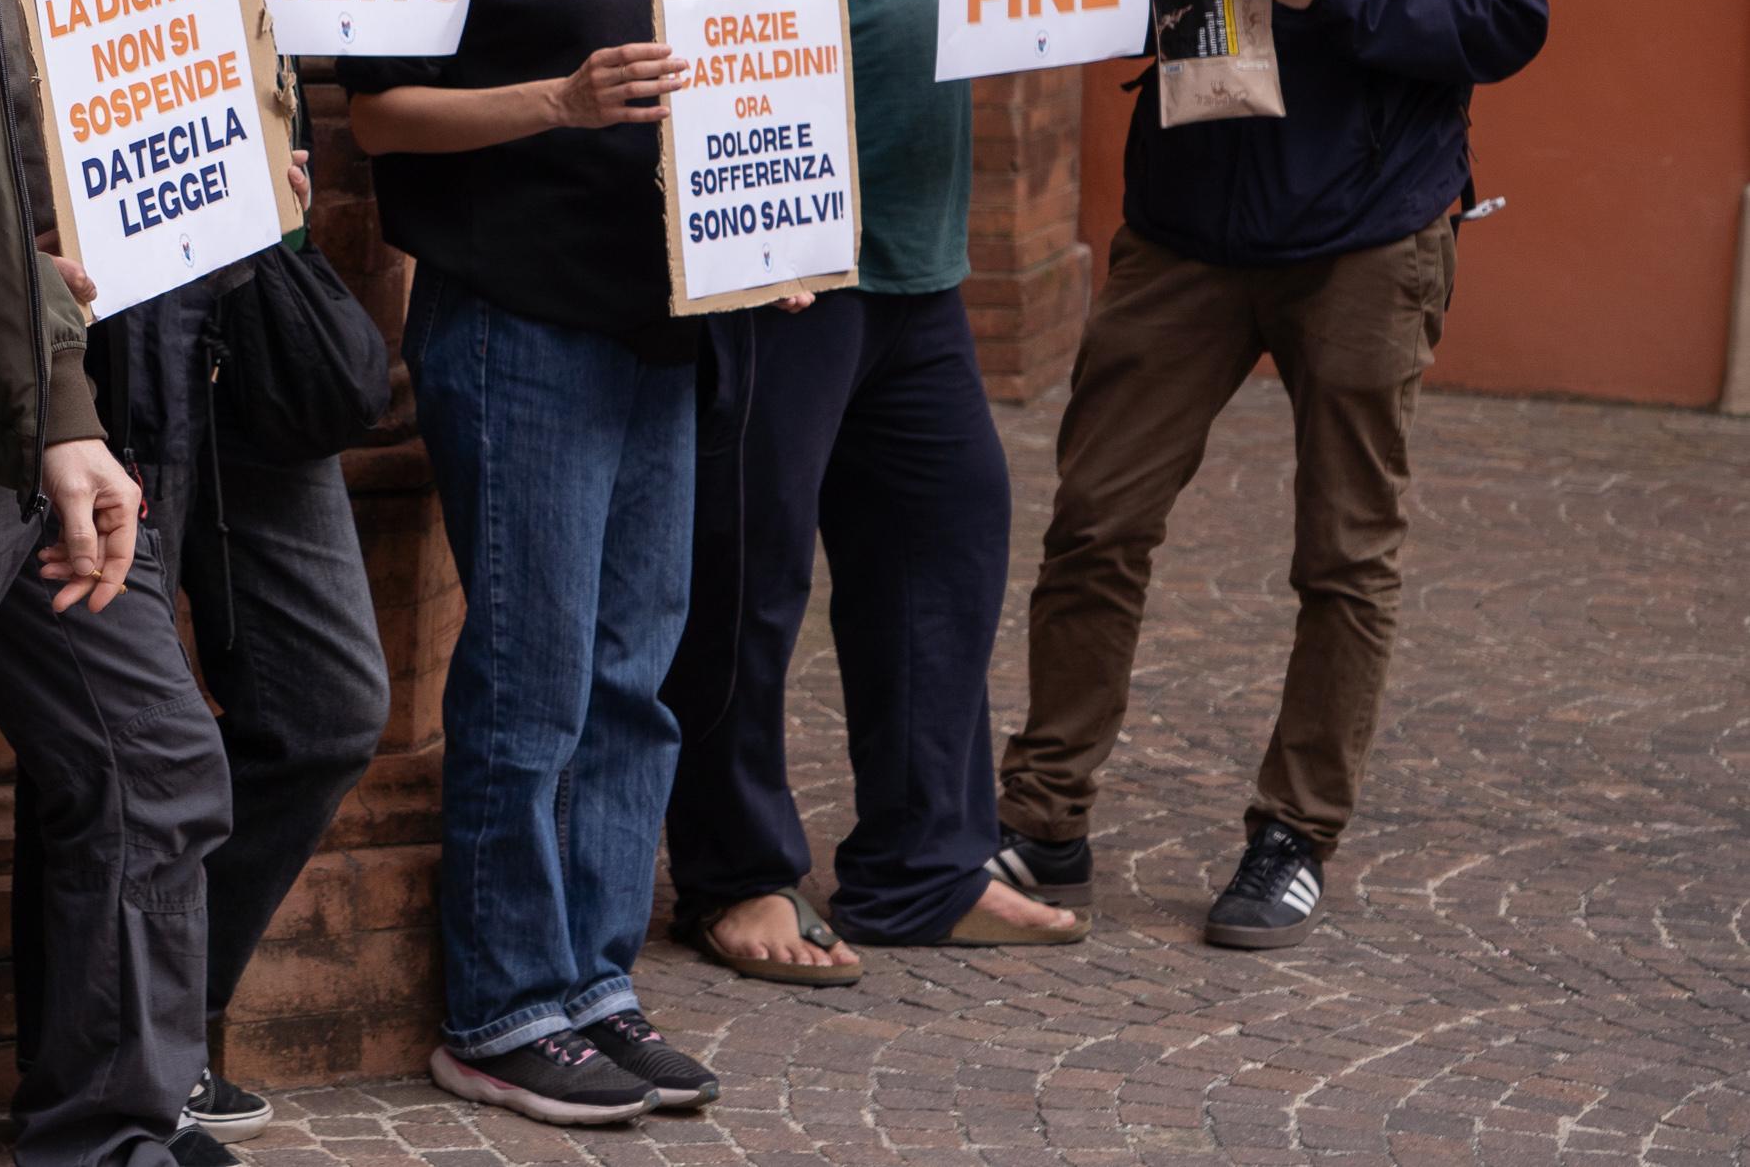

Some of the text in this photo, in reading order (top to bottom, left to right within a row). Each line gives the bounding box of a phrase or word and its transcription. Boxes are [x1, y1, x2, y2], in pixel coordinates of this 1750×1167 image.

[92, 14, 199, 83] NON SI
[705, 11, 799, 47] GRAZIE
[69, 51, 241, 142] SOSPENDE
[735, 95, 772, 119] ORA
[81, 107, 248, 199] DATECI LA
[706, 123, 812, 160] DOLORE E
[118, 161, 229, 237] LEGGE!
[690, 153, 834, 196] SOFFERENZA
[688, 191, 843, 243] SONO SALVI!
